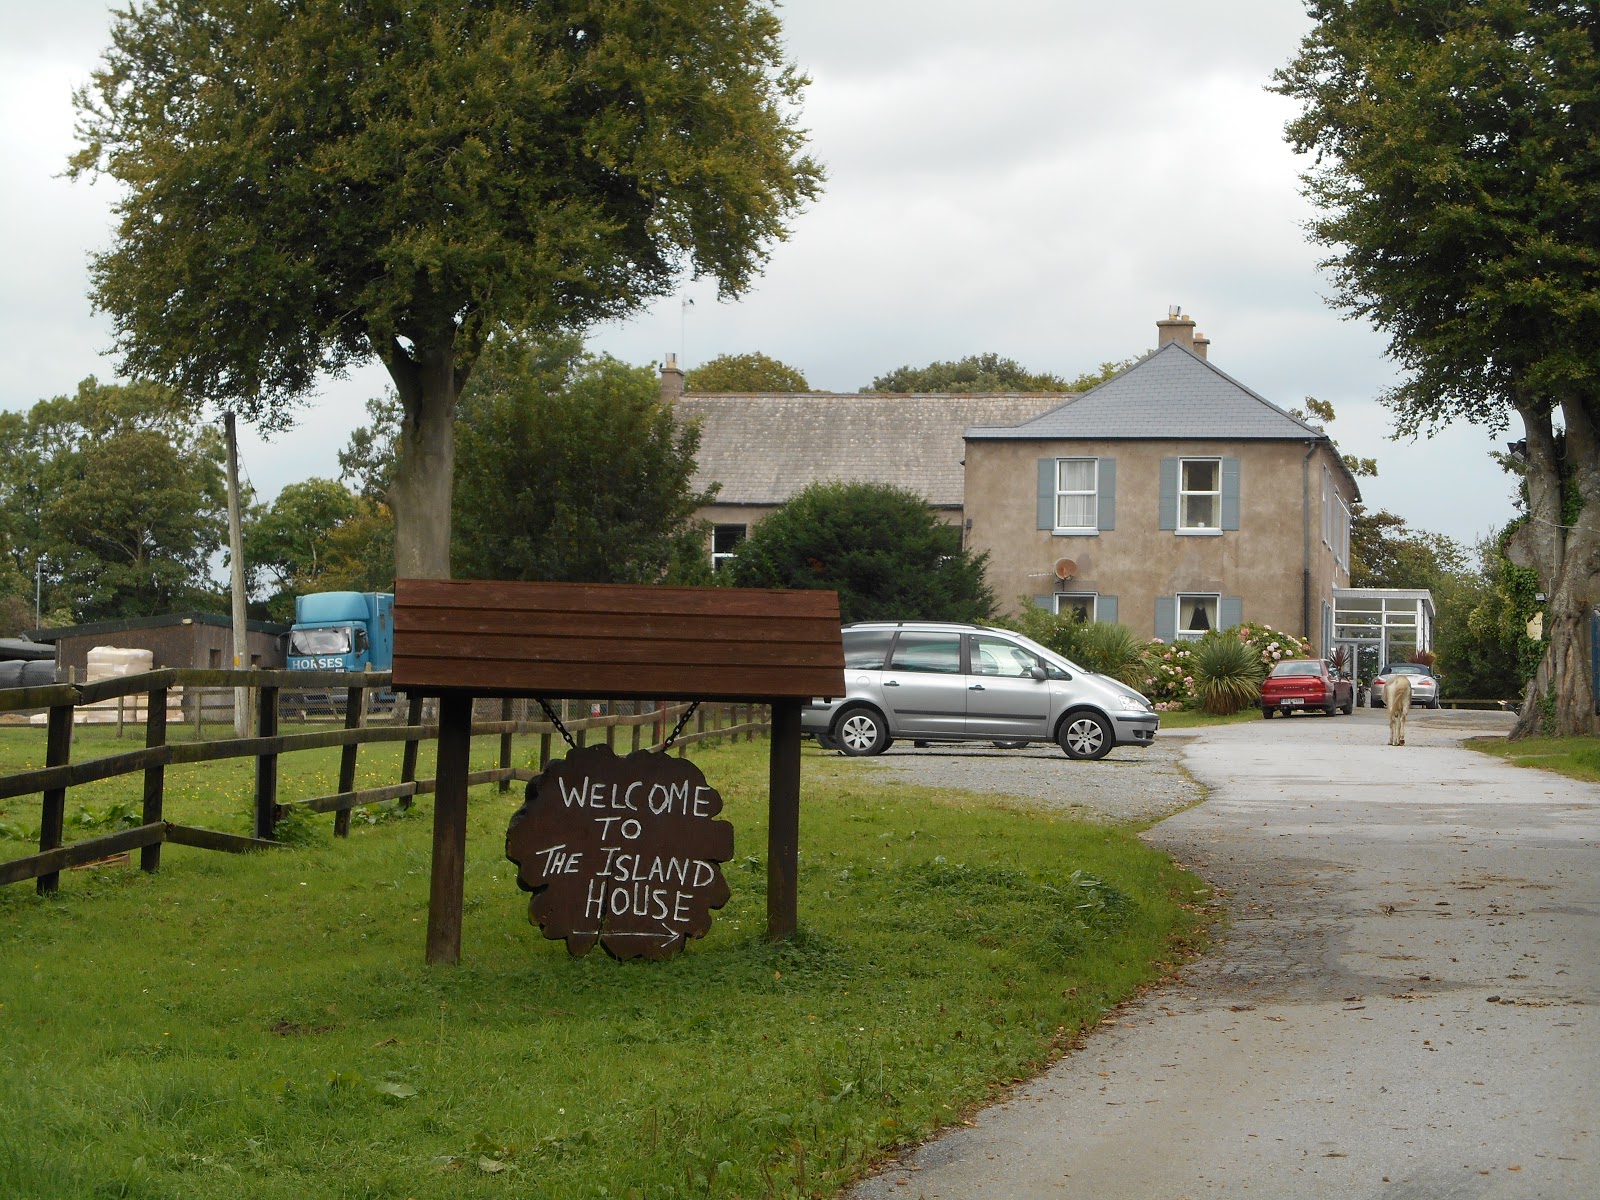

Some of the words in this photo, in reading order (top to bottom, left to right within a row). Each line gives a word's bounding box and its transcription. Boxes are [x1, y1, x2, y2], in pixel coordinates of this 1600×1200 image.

[292, 658, 343, 669] HORSES
[558, 776, 711, 817] WELCOME
[594, 817, 642, 841] TO
[536, 844, 583, 877] THE
[596, 847, 715, 887] ISLAND
[585, 879, 693, 922] HOUSE
